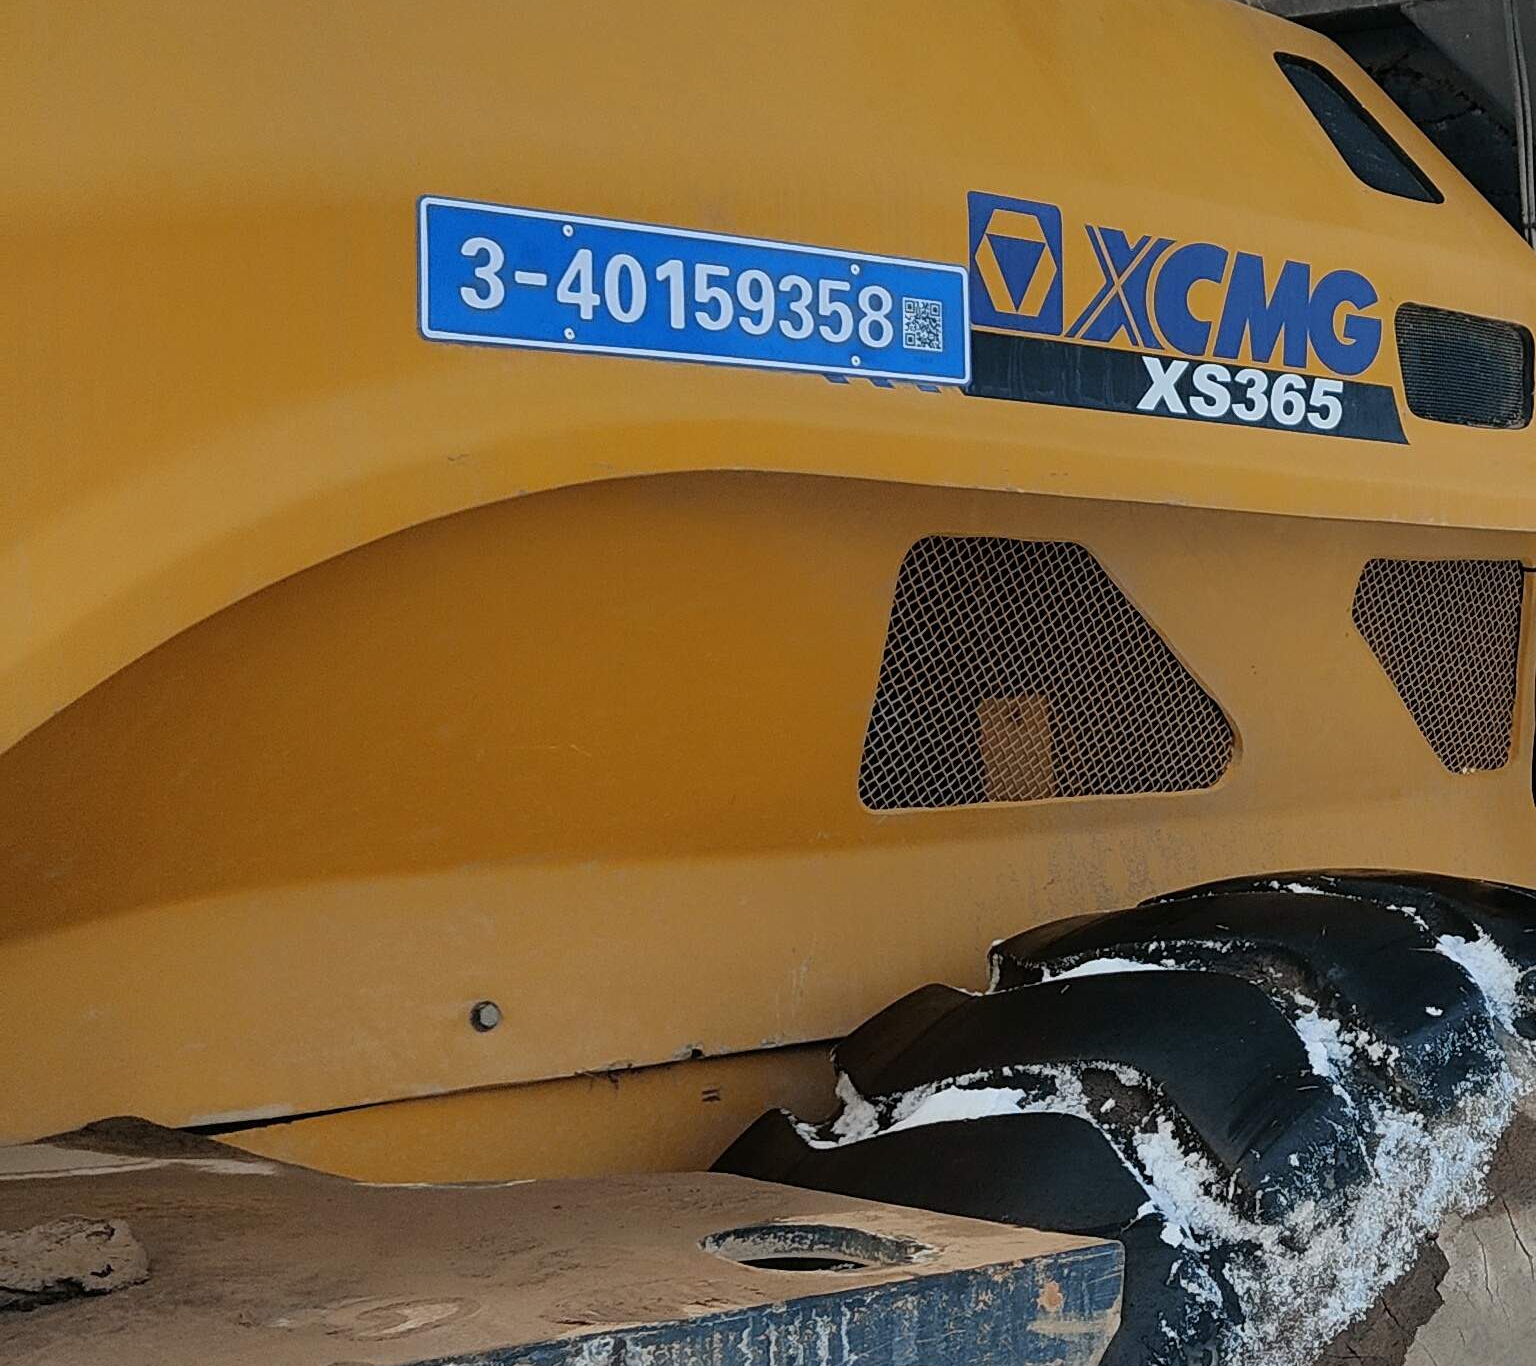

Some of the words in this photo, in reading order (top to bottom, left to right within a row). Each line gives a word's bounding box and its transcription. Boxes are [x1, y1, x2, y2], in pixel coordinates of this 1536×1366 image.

[460, 237, 893, 348] 3-40159358
[1065, 224, 1382, 376] XCMG
[1137, 356, 1343, 430] XS365
